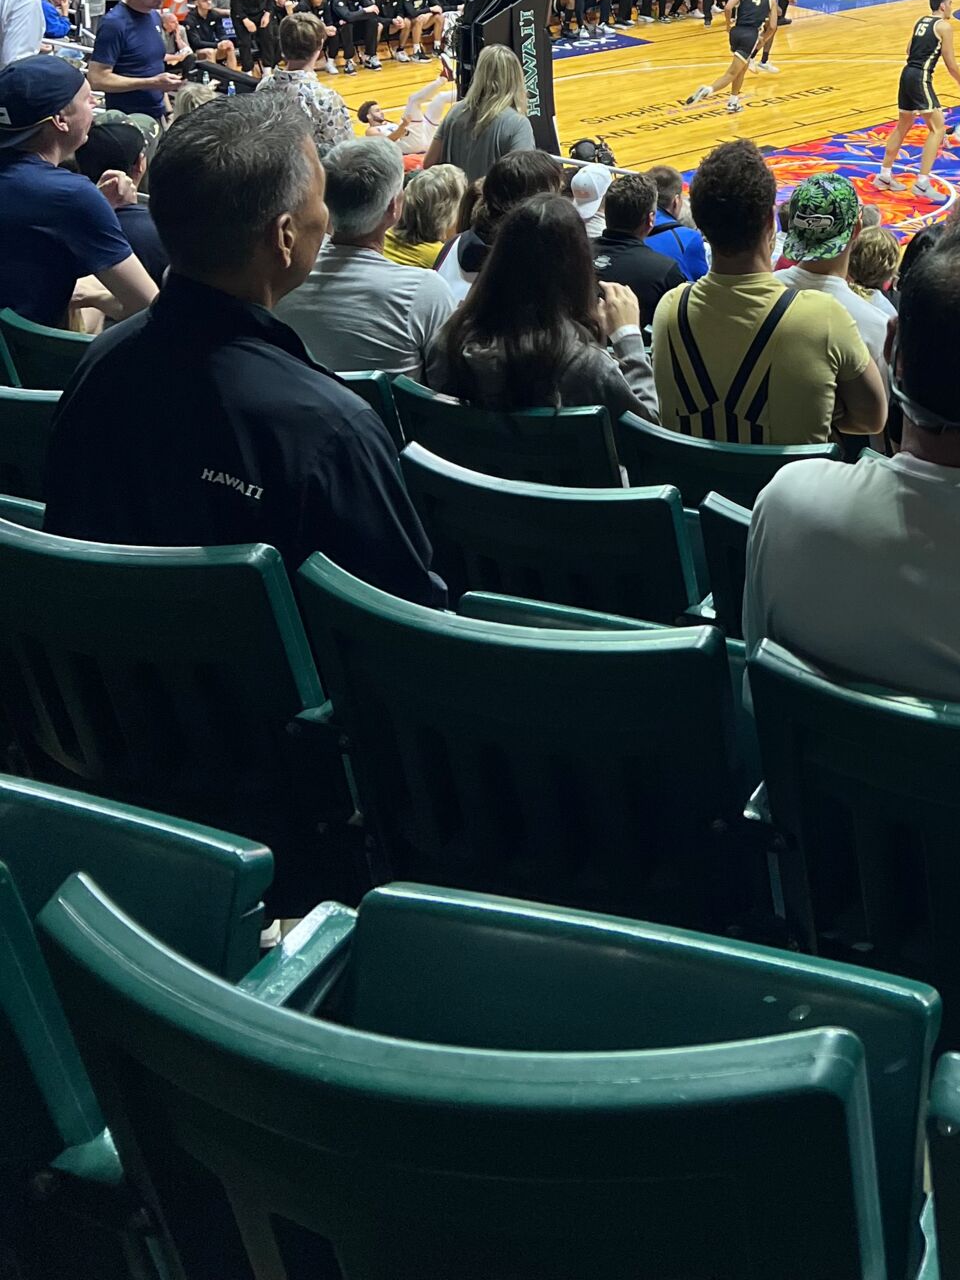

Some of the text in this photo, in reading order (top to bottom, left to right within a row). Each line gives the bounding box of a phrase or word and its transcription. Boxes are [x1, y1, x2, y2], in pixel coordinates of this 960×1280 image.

[914, 23, 926, 36] 15
[637, 106, 730, 132] SHERIF
[747, 85, 841, 108] CENTER
